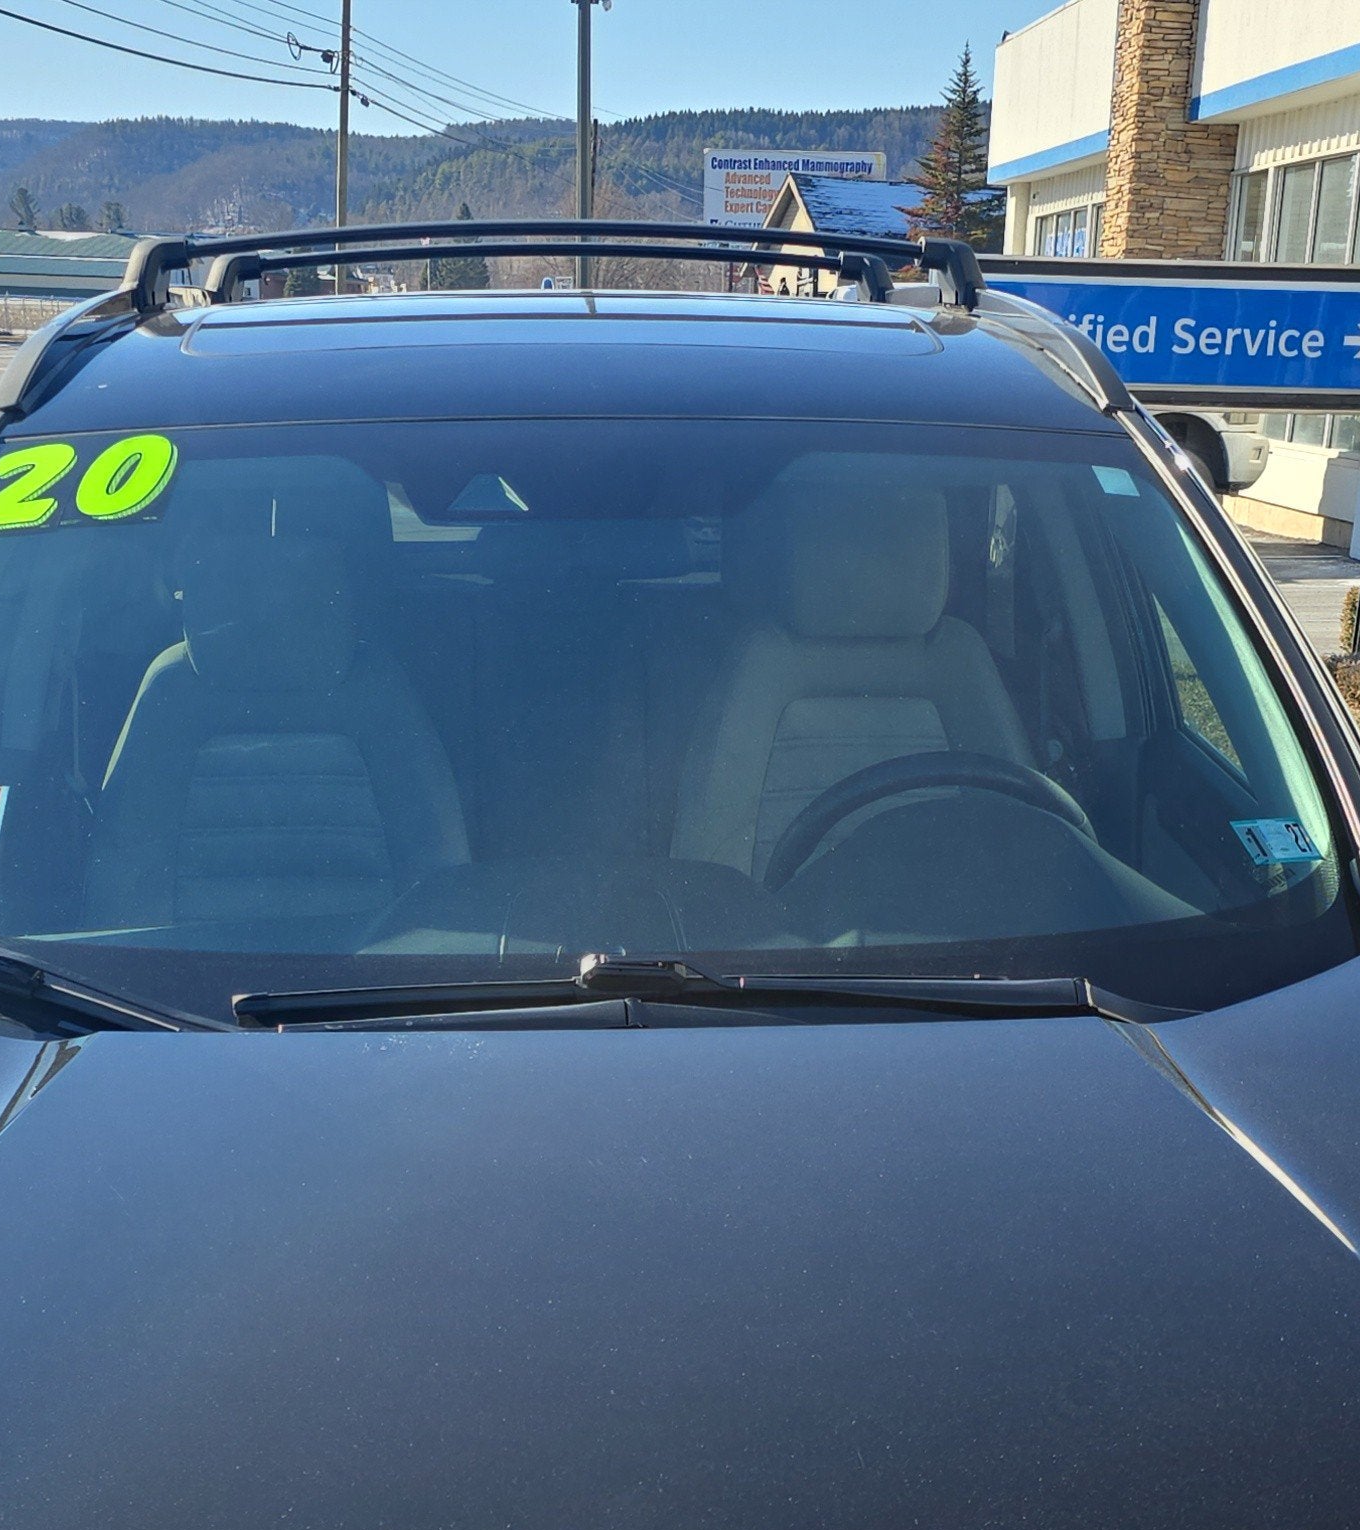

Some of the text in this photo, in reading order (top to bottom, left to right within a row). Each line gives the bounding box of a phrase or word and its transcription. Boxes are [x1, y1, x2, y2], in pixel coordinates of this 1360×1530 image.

[711, 156, 873, 174] Contrast Enhanced Mammography
[724, 171, 771, 185] Advanced
[724, 200, 754, 214] Expert
[1171, 317, 1325, 358] Service
